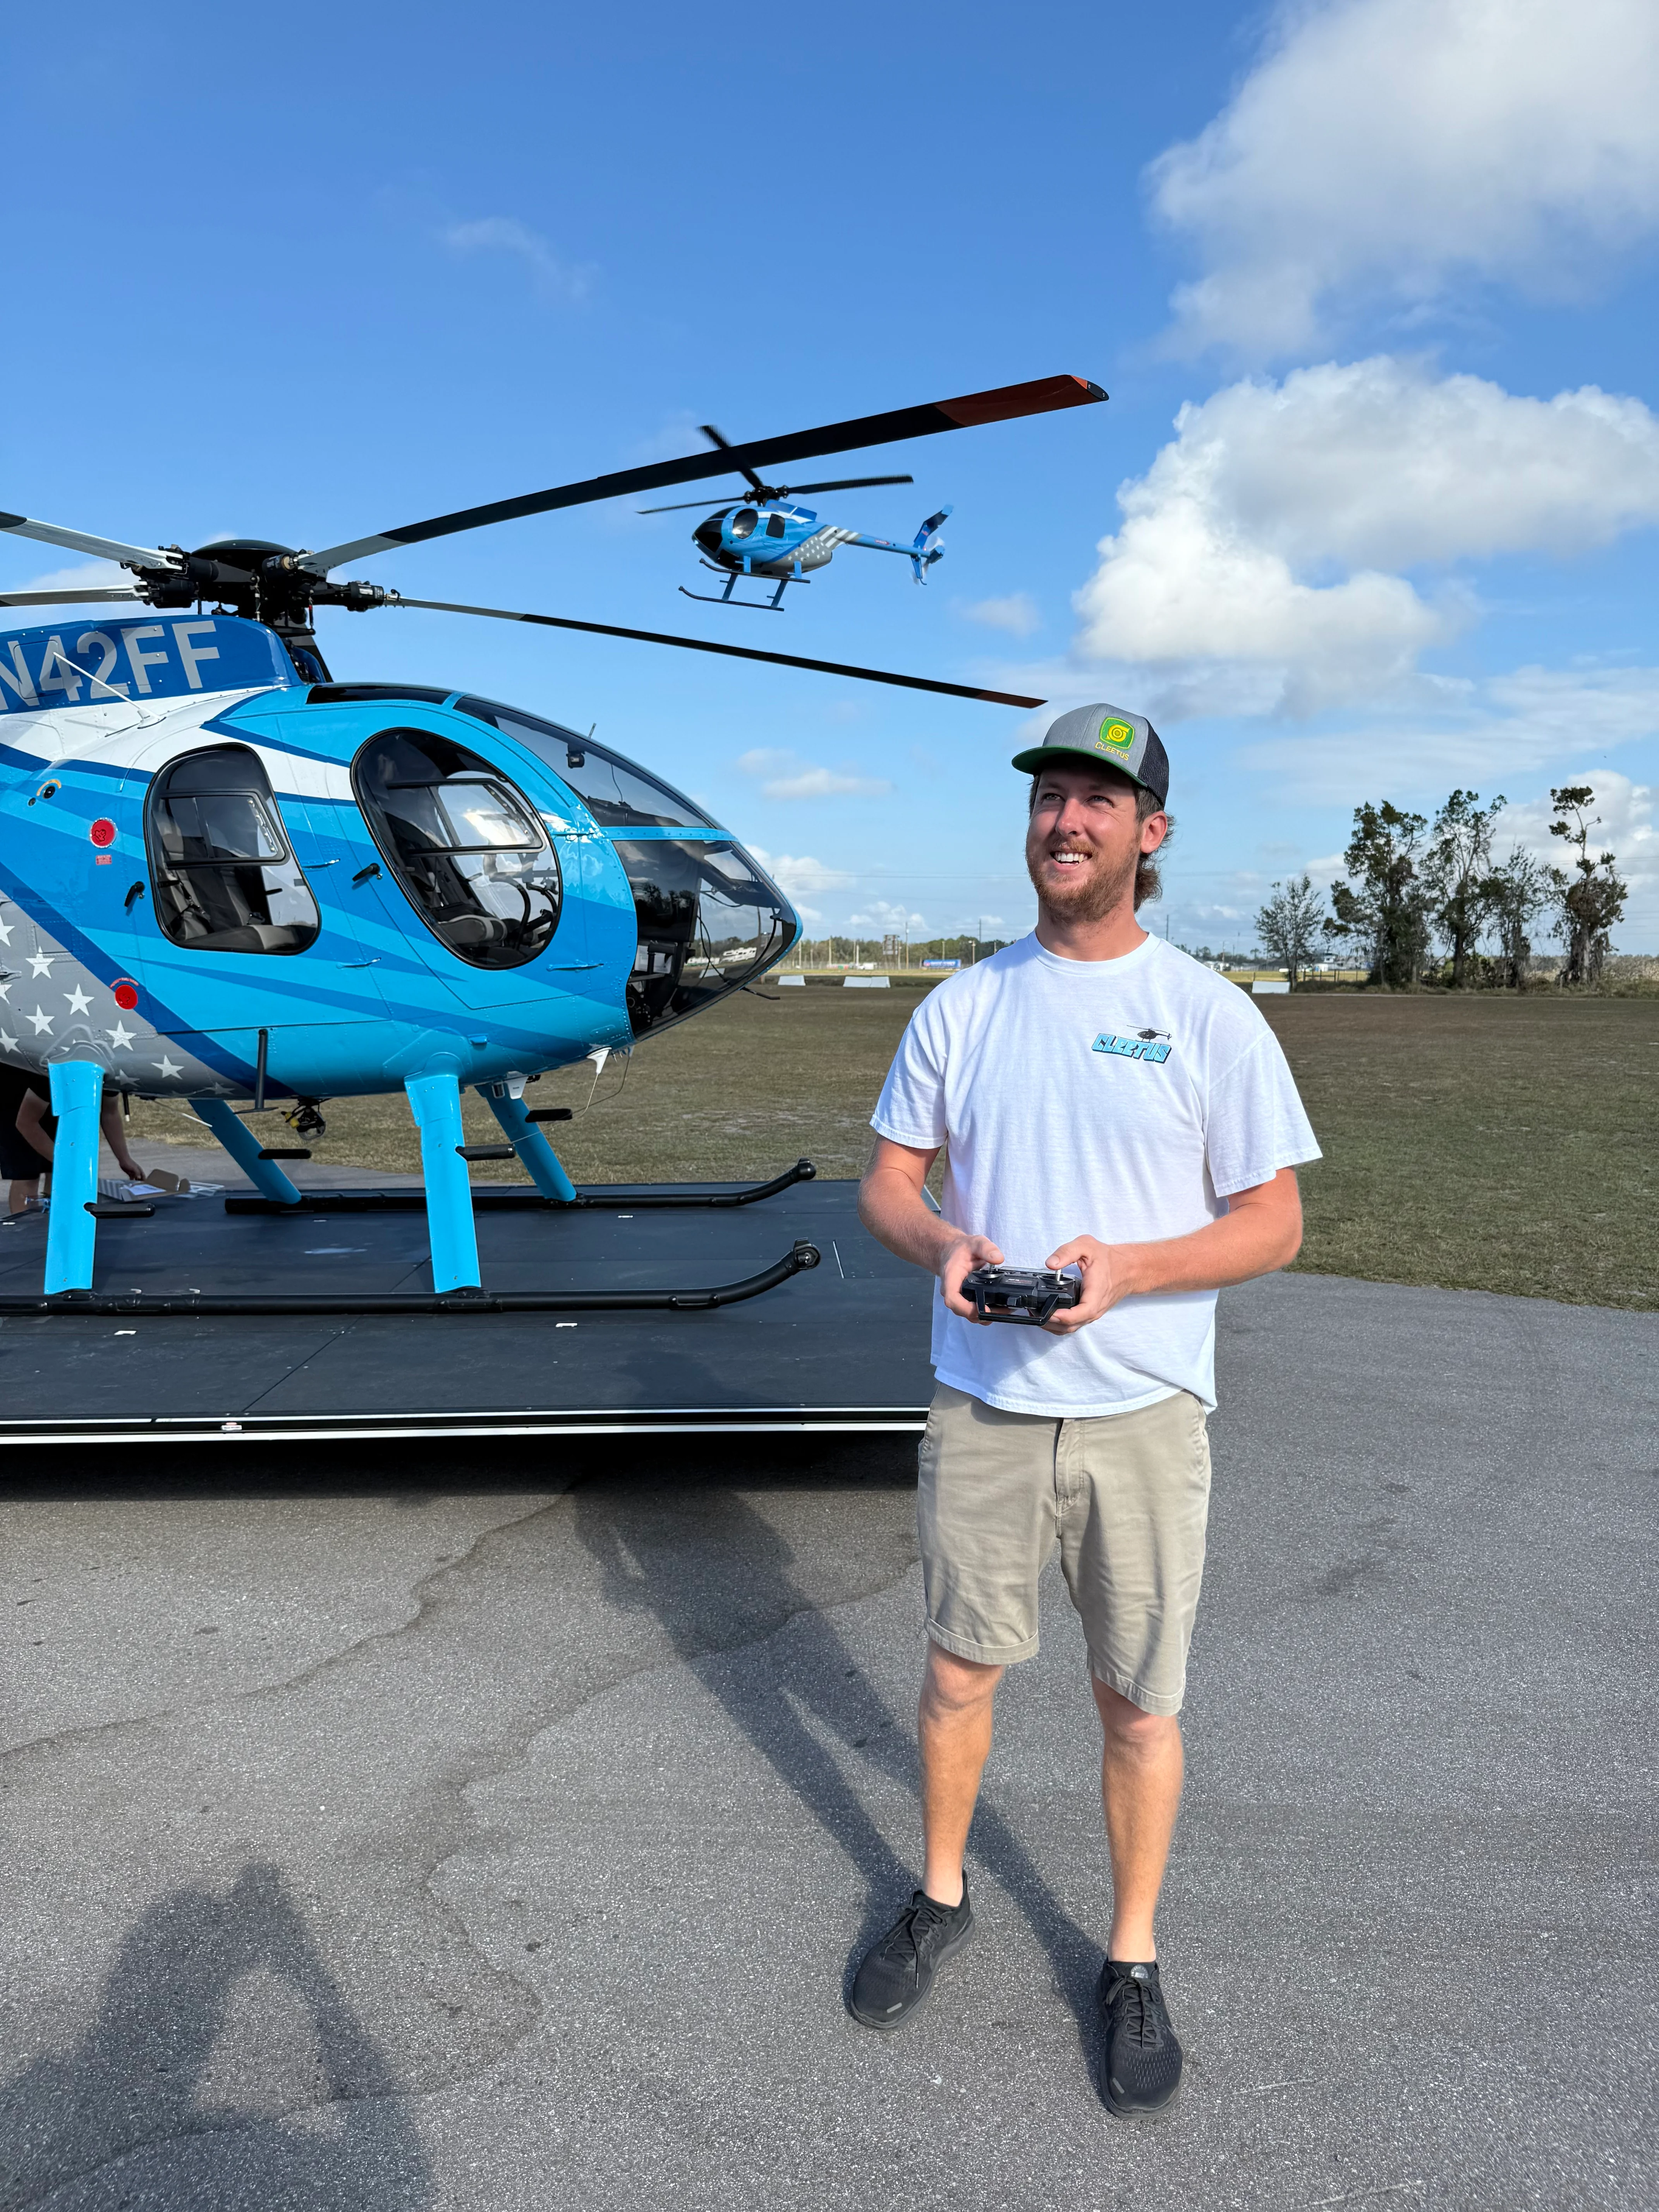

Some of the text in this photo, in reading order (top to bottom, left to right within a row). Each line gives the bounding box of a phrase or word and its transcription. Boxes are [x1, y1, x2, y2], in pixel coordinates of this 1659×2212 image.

[0, 620, 220, 710] N42FF
[1095, 742, 1129, 761] CLEETUS
[1092, 1033, 1171, 1064] CLEETUS
